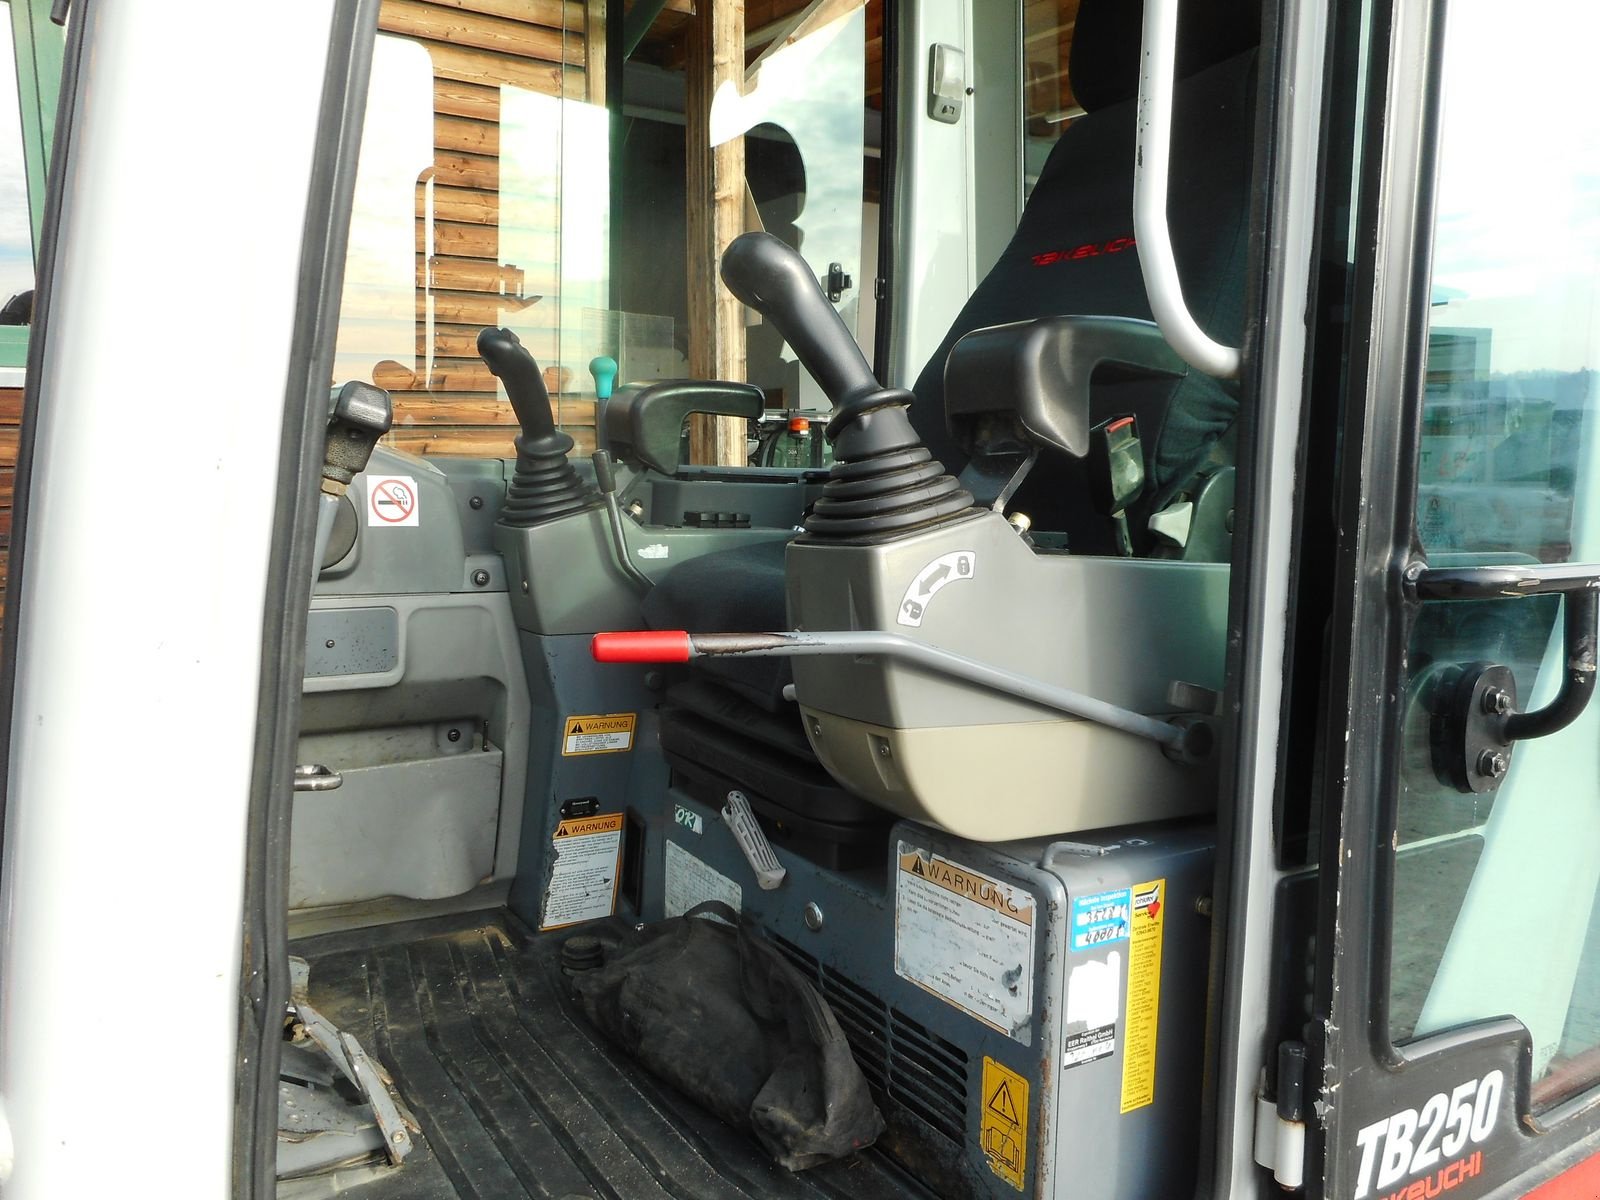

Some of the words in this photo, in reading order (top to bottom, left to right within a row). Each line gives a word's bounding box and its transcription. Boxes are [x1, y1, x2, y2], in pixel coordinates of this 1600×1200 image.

[585, 720, 628, 730] WARNUNG
[571, 820, 616, 833] WARNUNG
[928, 864, 1018, 914] WARNUNG
[1068, 1039, 1080, 1048] EER
[1097, 1028, 1113, 1039] GmbH
[1354, 1070, 1504, 1200] TB250
